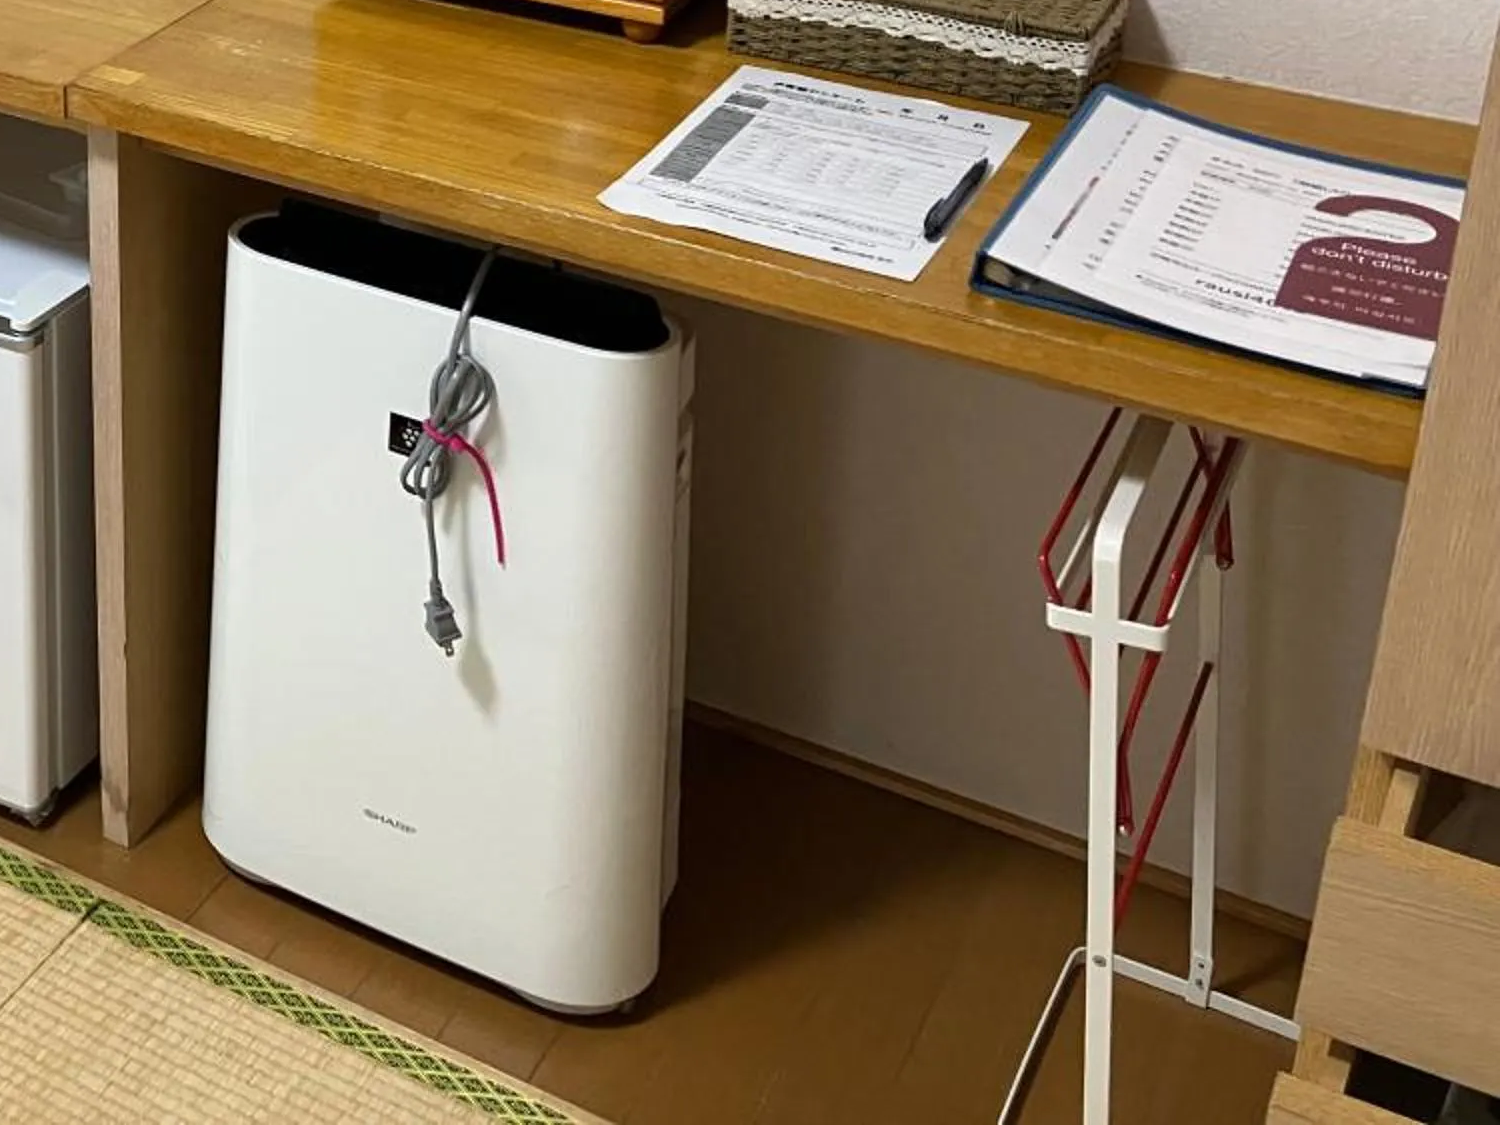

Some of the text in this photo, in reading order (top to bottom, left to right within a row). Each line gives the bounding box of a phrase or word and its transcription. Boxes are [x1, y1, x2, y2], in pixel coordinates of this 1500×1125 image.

[1310, 246, 1365, 265] don't
[1371, 259, 1449, 281] disturb
[1341, 241, 1417, 266] Please
